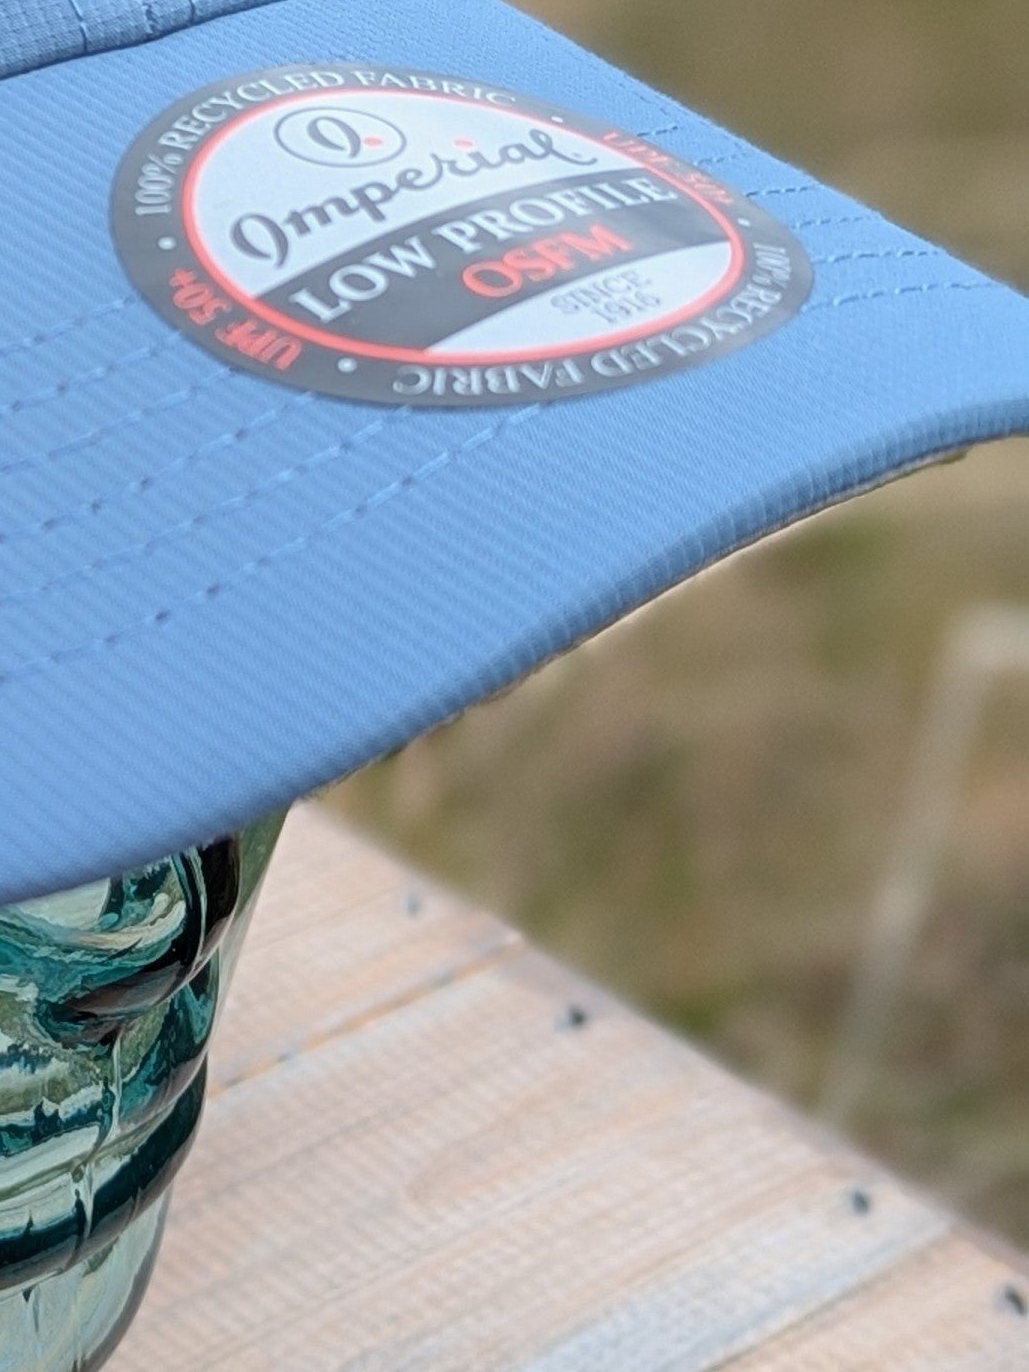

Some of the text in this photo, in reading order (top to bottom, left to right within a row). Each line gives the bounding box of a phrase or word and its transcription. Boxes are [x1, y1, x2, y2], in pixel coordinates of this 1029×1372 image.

[134, 70, 517, 216] 100% RECYCLED FABRIC
[229, 128, 598, 268] Imperial
[288, 177, 678, 323] LOW PROFILE
[462, 224, 632, 298] OSFM
[550, 269, 652, 314] SINCE
[392, 357, 585, 396] FABRIC
[590, 283, 783, 377] RECYCLED
